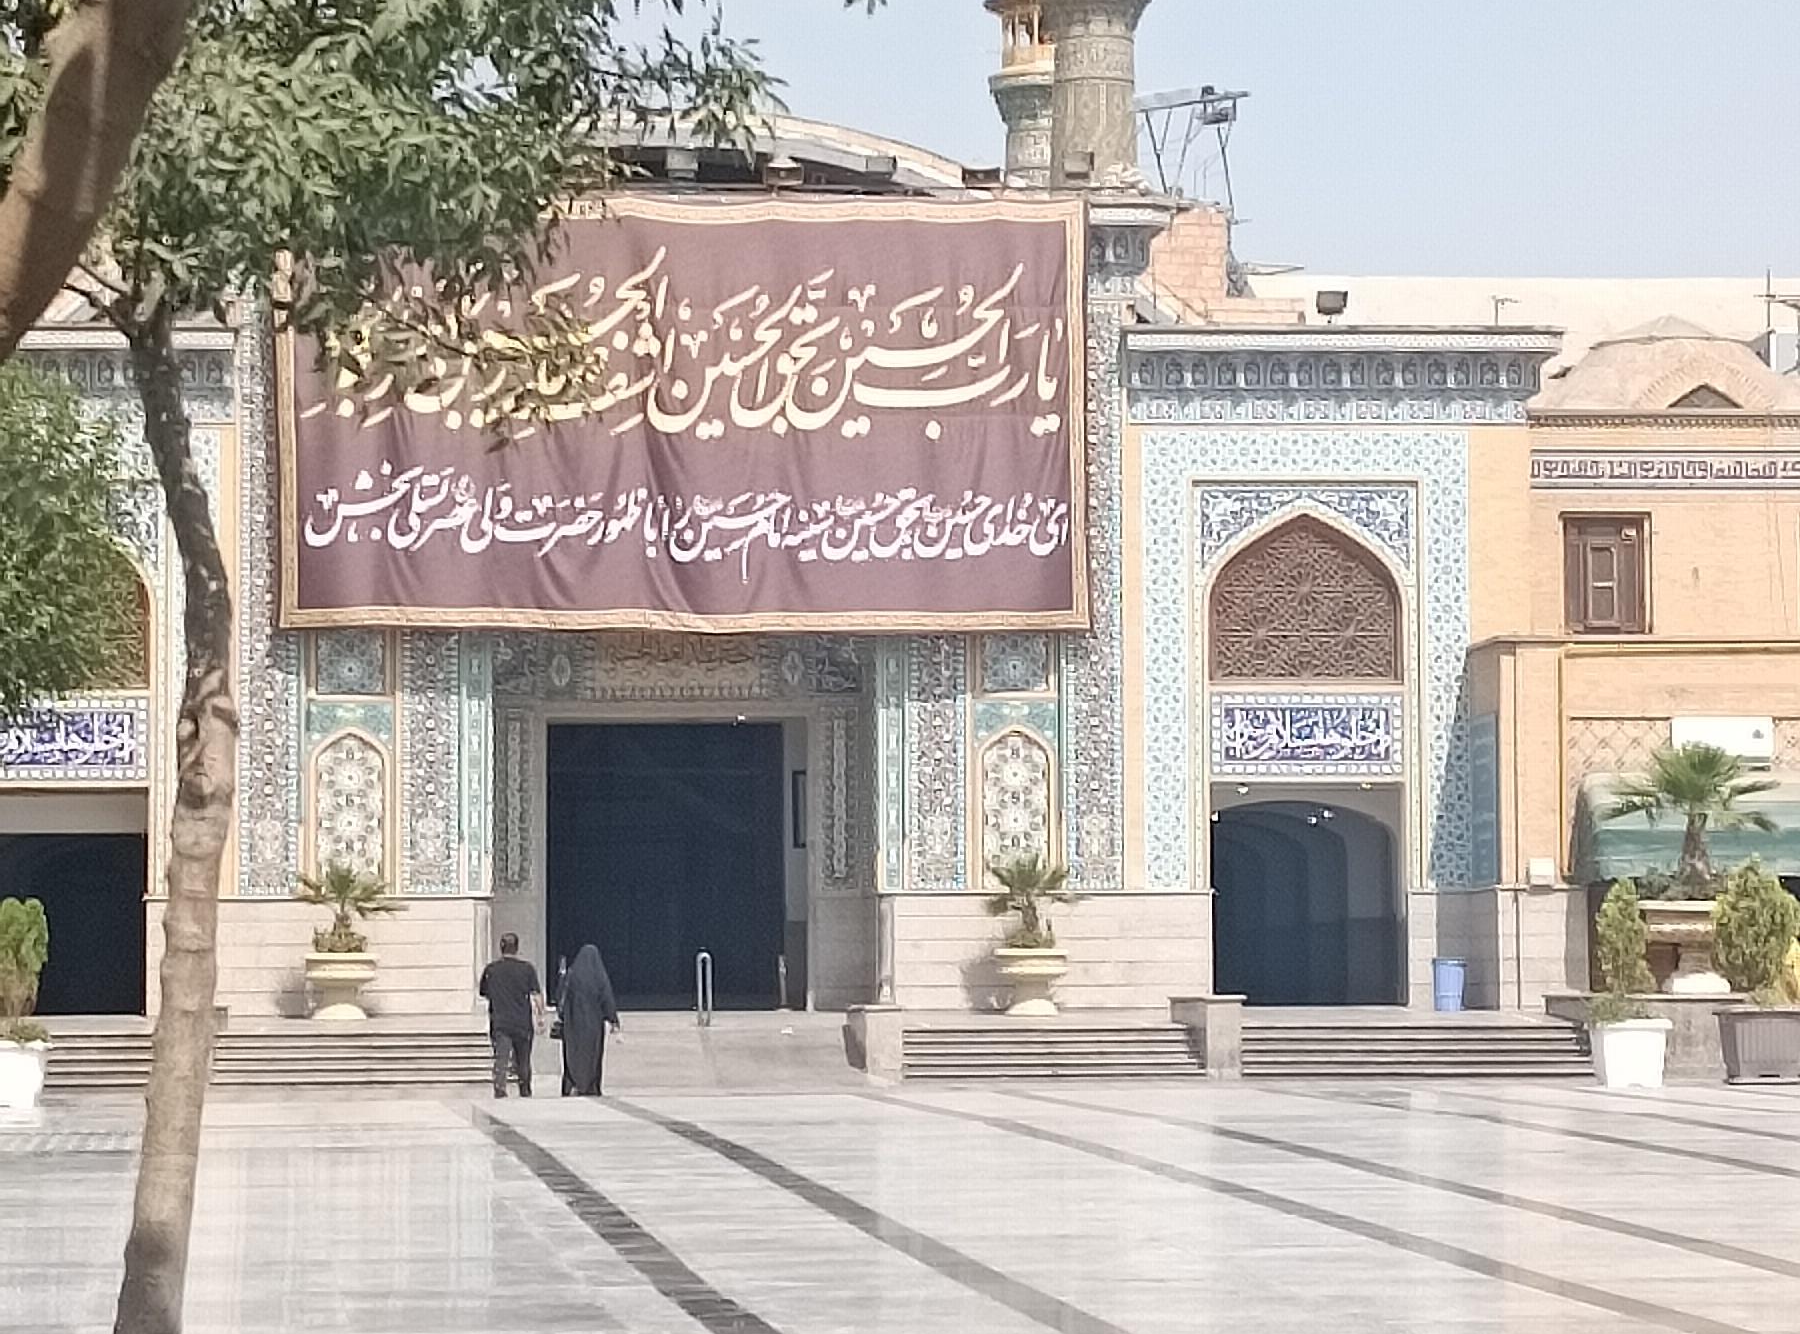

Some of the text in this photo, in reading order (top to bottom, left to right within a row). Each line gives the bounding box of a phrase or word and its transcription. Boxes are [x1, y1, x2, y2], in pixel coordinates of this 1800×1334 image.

[646, 284, 802, 441] الحسین
[784, 261, 1025, 440] الحسین
[303, 459, 425, 548] بخش
[459, 483, 513, 554] ولی
[493, 493, 604, 558] حضرت
[586, 487, 649, 546] ظهور
[669, 490, 792, 562] حسین
[821, 492, 901, 563] حسین
[913, 490, 993, 560] حسین
[963, 492, 1034, 556] خدای
